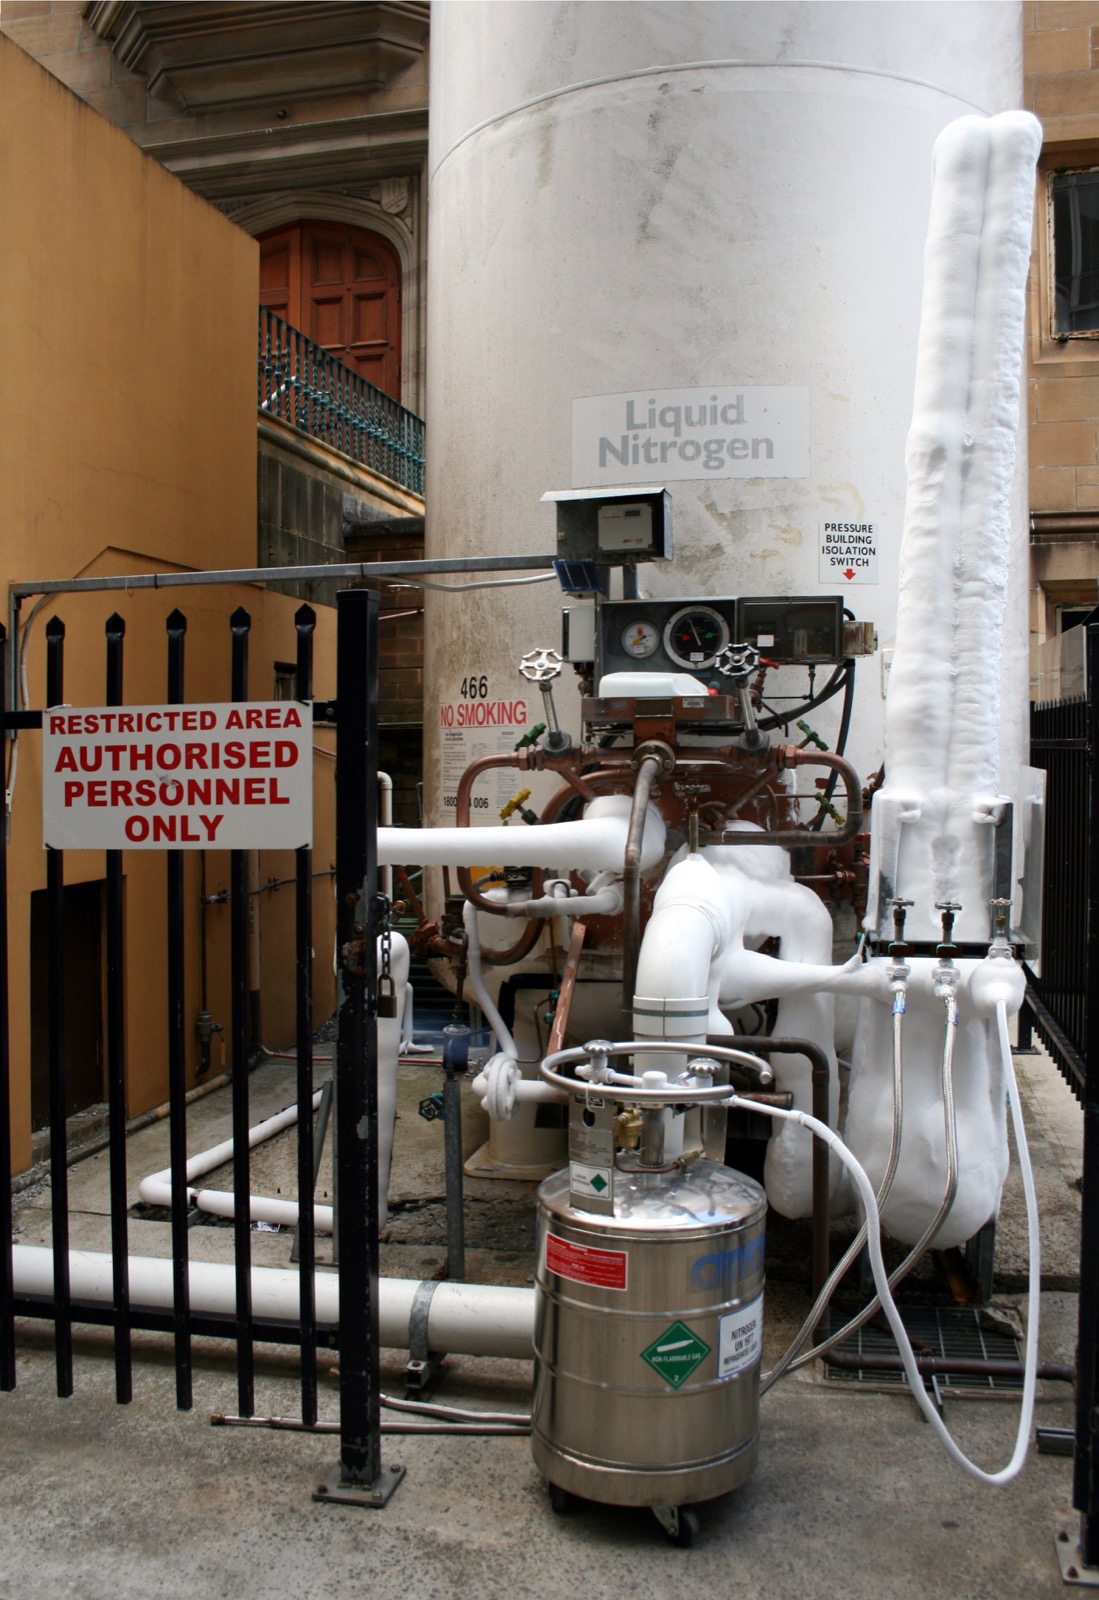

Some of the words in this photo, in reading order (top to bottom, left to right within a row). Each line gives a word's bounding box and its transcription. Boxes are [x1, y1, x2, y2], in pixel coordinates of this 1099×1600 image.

[625, 394, 746, 437] Liquid
[598, 433, 774, 470] Nitrogen
[824, 522, 874, 534] PRESSURE
[821, 545, 876, 556] ISOLATION
[825, 534, 872, 545] BUILDING
[830, 556, 870, 567] SWITCH
[461, 676, 488, 698] 466
[50, 710, 217, 735] RESTRICTED
[225, 708, 302, 730] AREA
[441, 706, 454, 726] NO
[458, 701, 526, 726] SMOKING
[54, 740, 299, 773] AUTHORISED
[64, 777, 290, 807] PERSONNEL
[473, 797, 489, 809] 006
[124, 814, 224, 842] ONLY
[731, 1319, 757, 1341] NITROGEN
[734, 1339, 744, 1352] UN
[651, 1354, 691, 1363] NON-FLAMMABLE
[673, 1374, 680, 1383] 2
